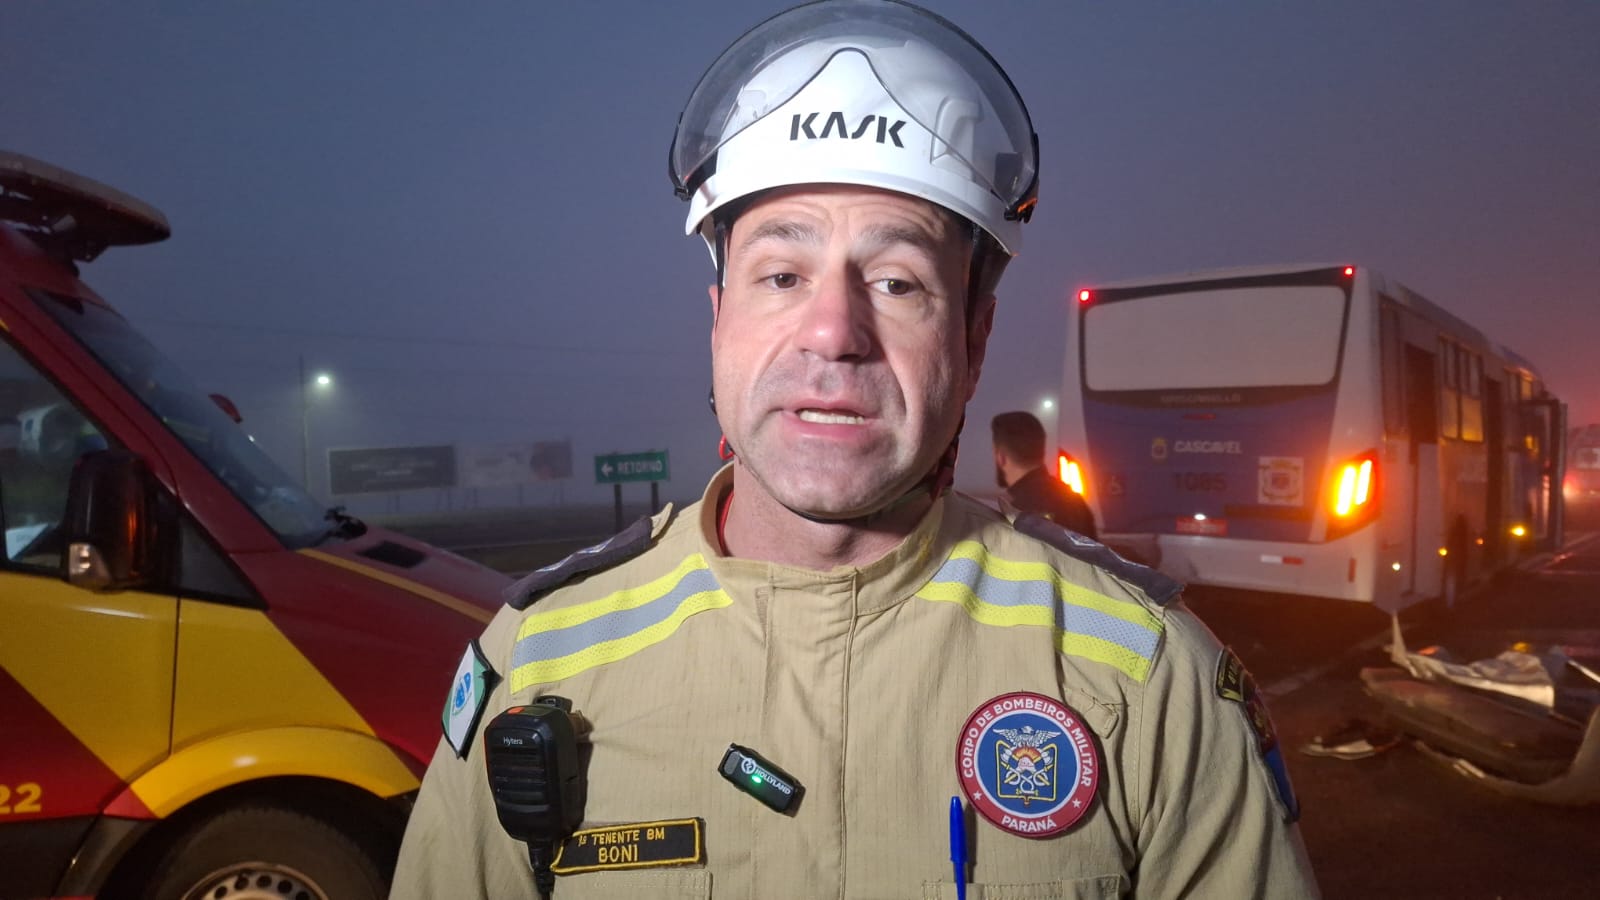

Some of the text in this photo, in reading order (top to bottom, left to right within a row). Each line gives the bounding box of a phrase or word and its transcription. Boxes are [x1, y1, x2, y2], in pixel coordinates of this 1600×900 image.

[789, 111, 907, 149] KASK
[1174, 440, 1243, 454] CASCAVEL
[617, 460, 663, 475] RETORNO
[503, 736, 523, 746] Hytera
[962, 698, 1093, 787] CORPO DE BOMBEIROS MILITAR
[755, 768, 791, 795] HOLLYLAND
[1001, 815, 1057, 832] PARANÁ
[591, 829, 640, 846] TENENTE
[646, 827, 665, 840] BM
[598, 844, 638, 863] BONI
